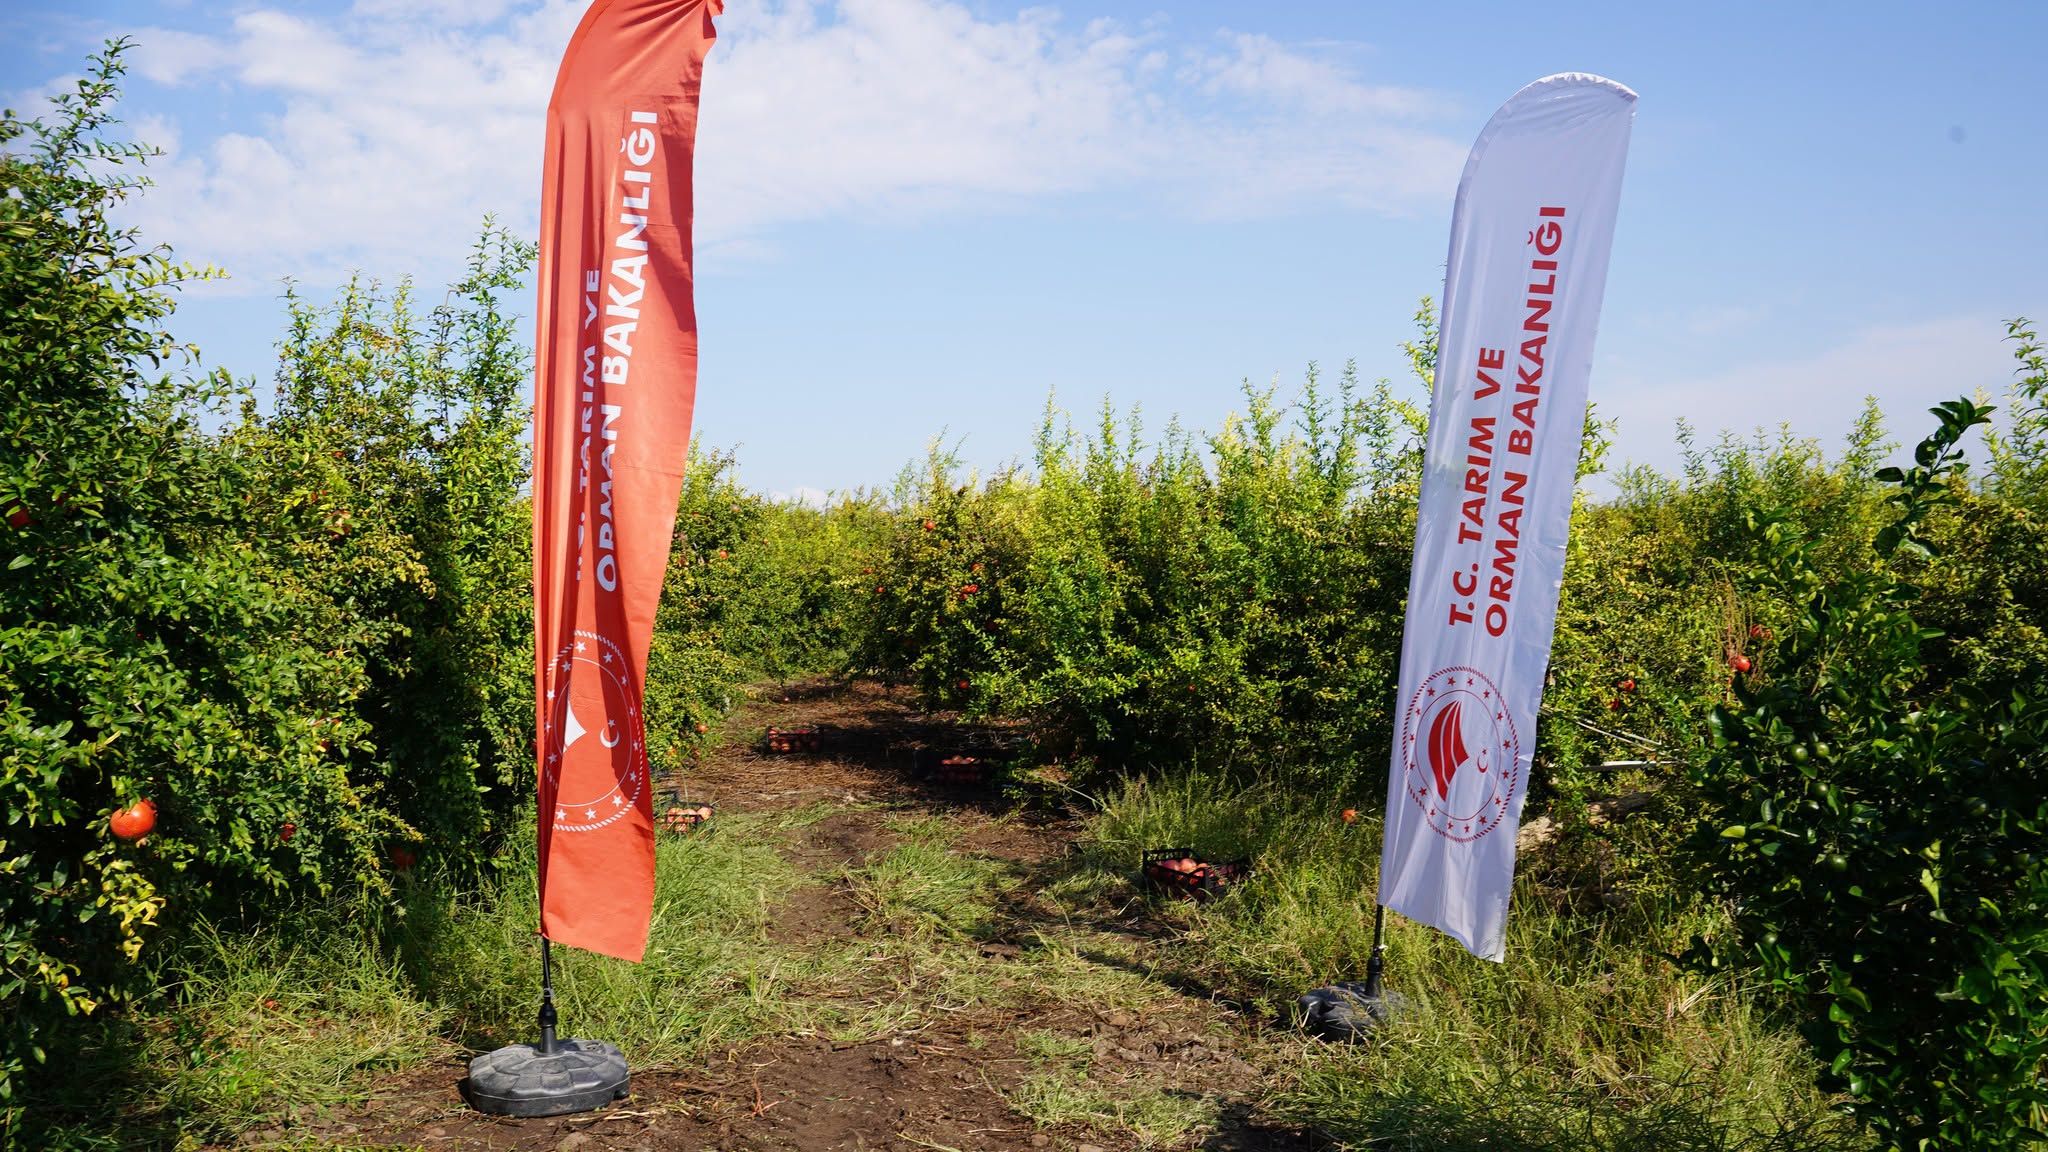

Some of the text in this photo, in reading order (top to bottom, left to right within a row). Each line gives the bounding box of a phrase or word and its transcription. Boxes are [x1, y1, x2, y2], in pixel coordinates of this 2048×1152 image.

[584, 269, 600, 330] VE
[601, 110, 658, 385] BAKANLIĞI
[1449, 348, 1505, 625] T.C. TARIM VE
[1484, 207, 1565, 637] ORMAN BAKANLIĞI
